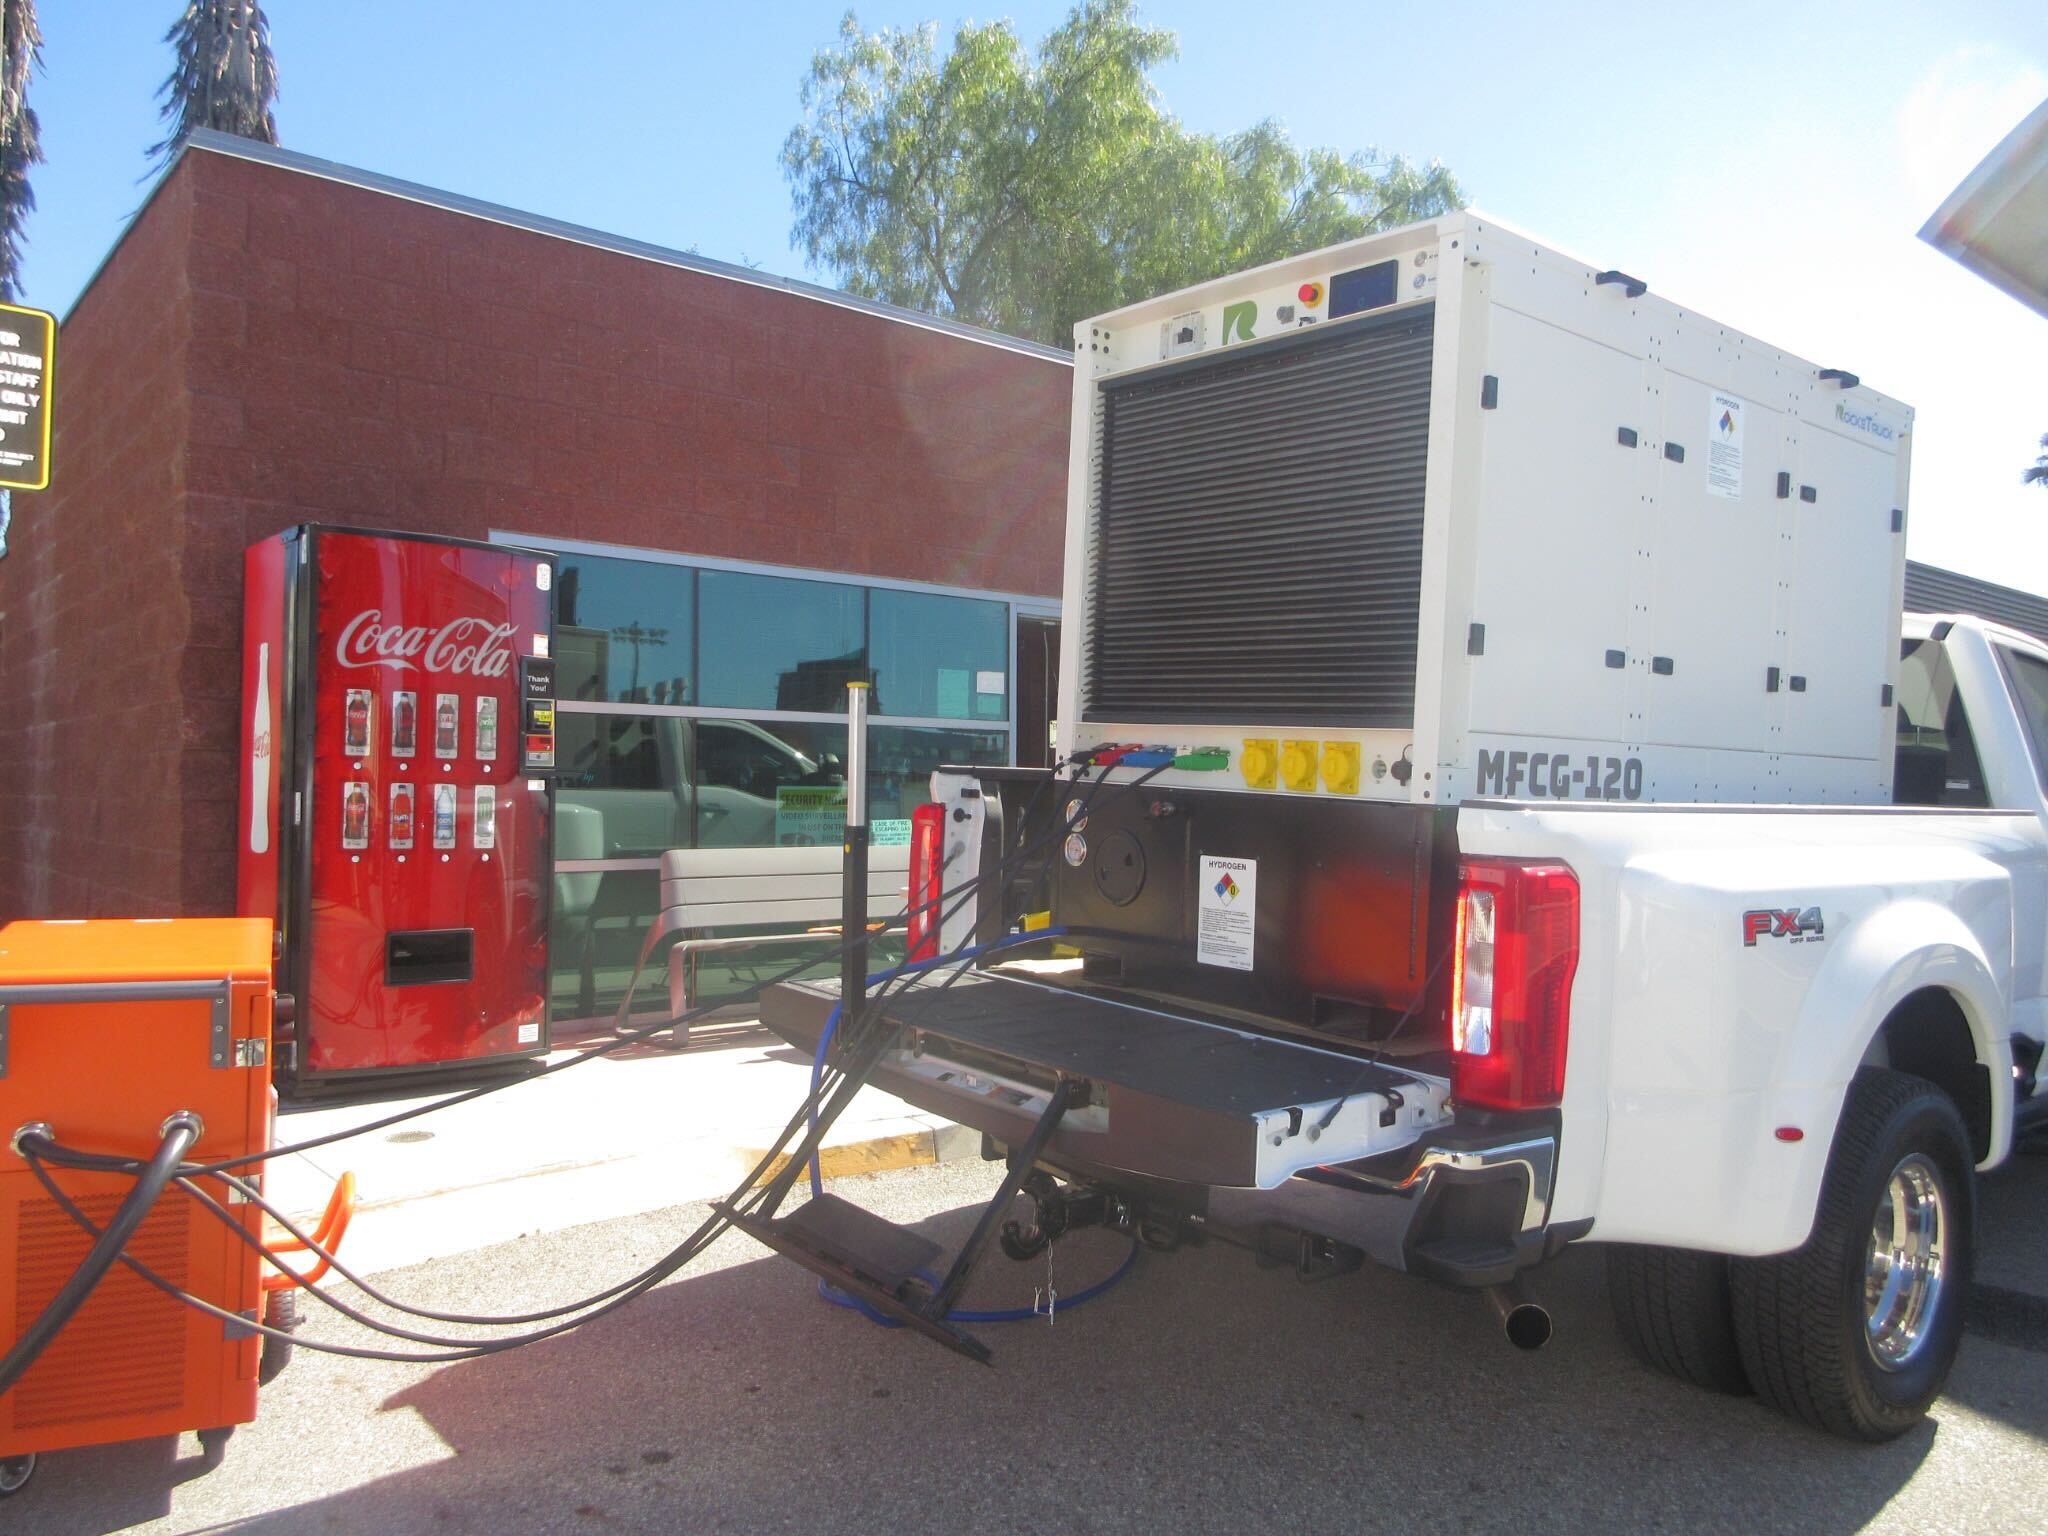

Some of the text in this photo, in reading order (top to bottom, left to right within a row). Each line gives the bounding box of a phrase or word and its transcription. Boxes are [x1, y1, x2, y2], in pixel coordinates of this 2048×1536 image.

[2, 390, 40, 408] ONLY
[337, 609, 520, 678] Coca-Cola
[527, 675, 550, 683] Thank
[530, 684, 547, 692] You!
[1476, 749, 1643, 801] MFCG-120
[1208, 860, 1247, 871] HYDROGEN
[1743, 907, 1824, 947] FX4
